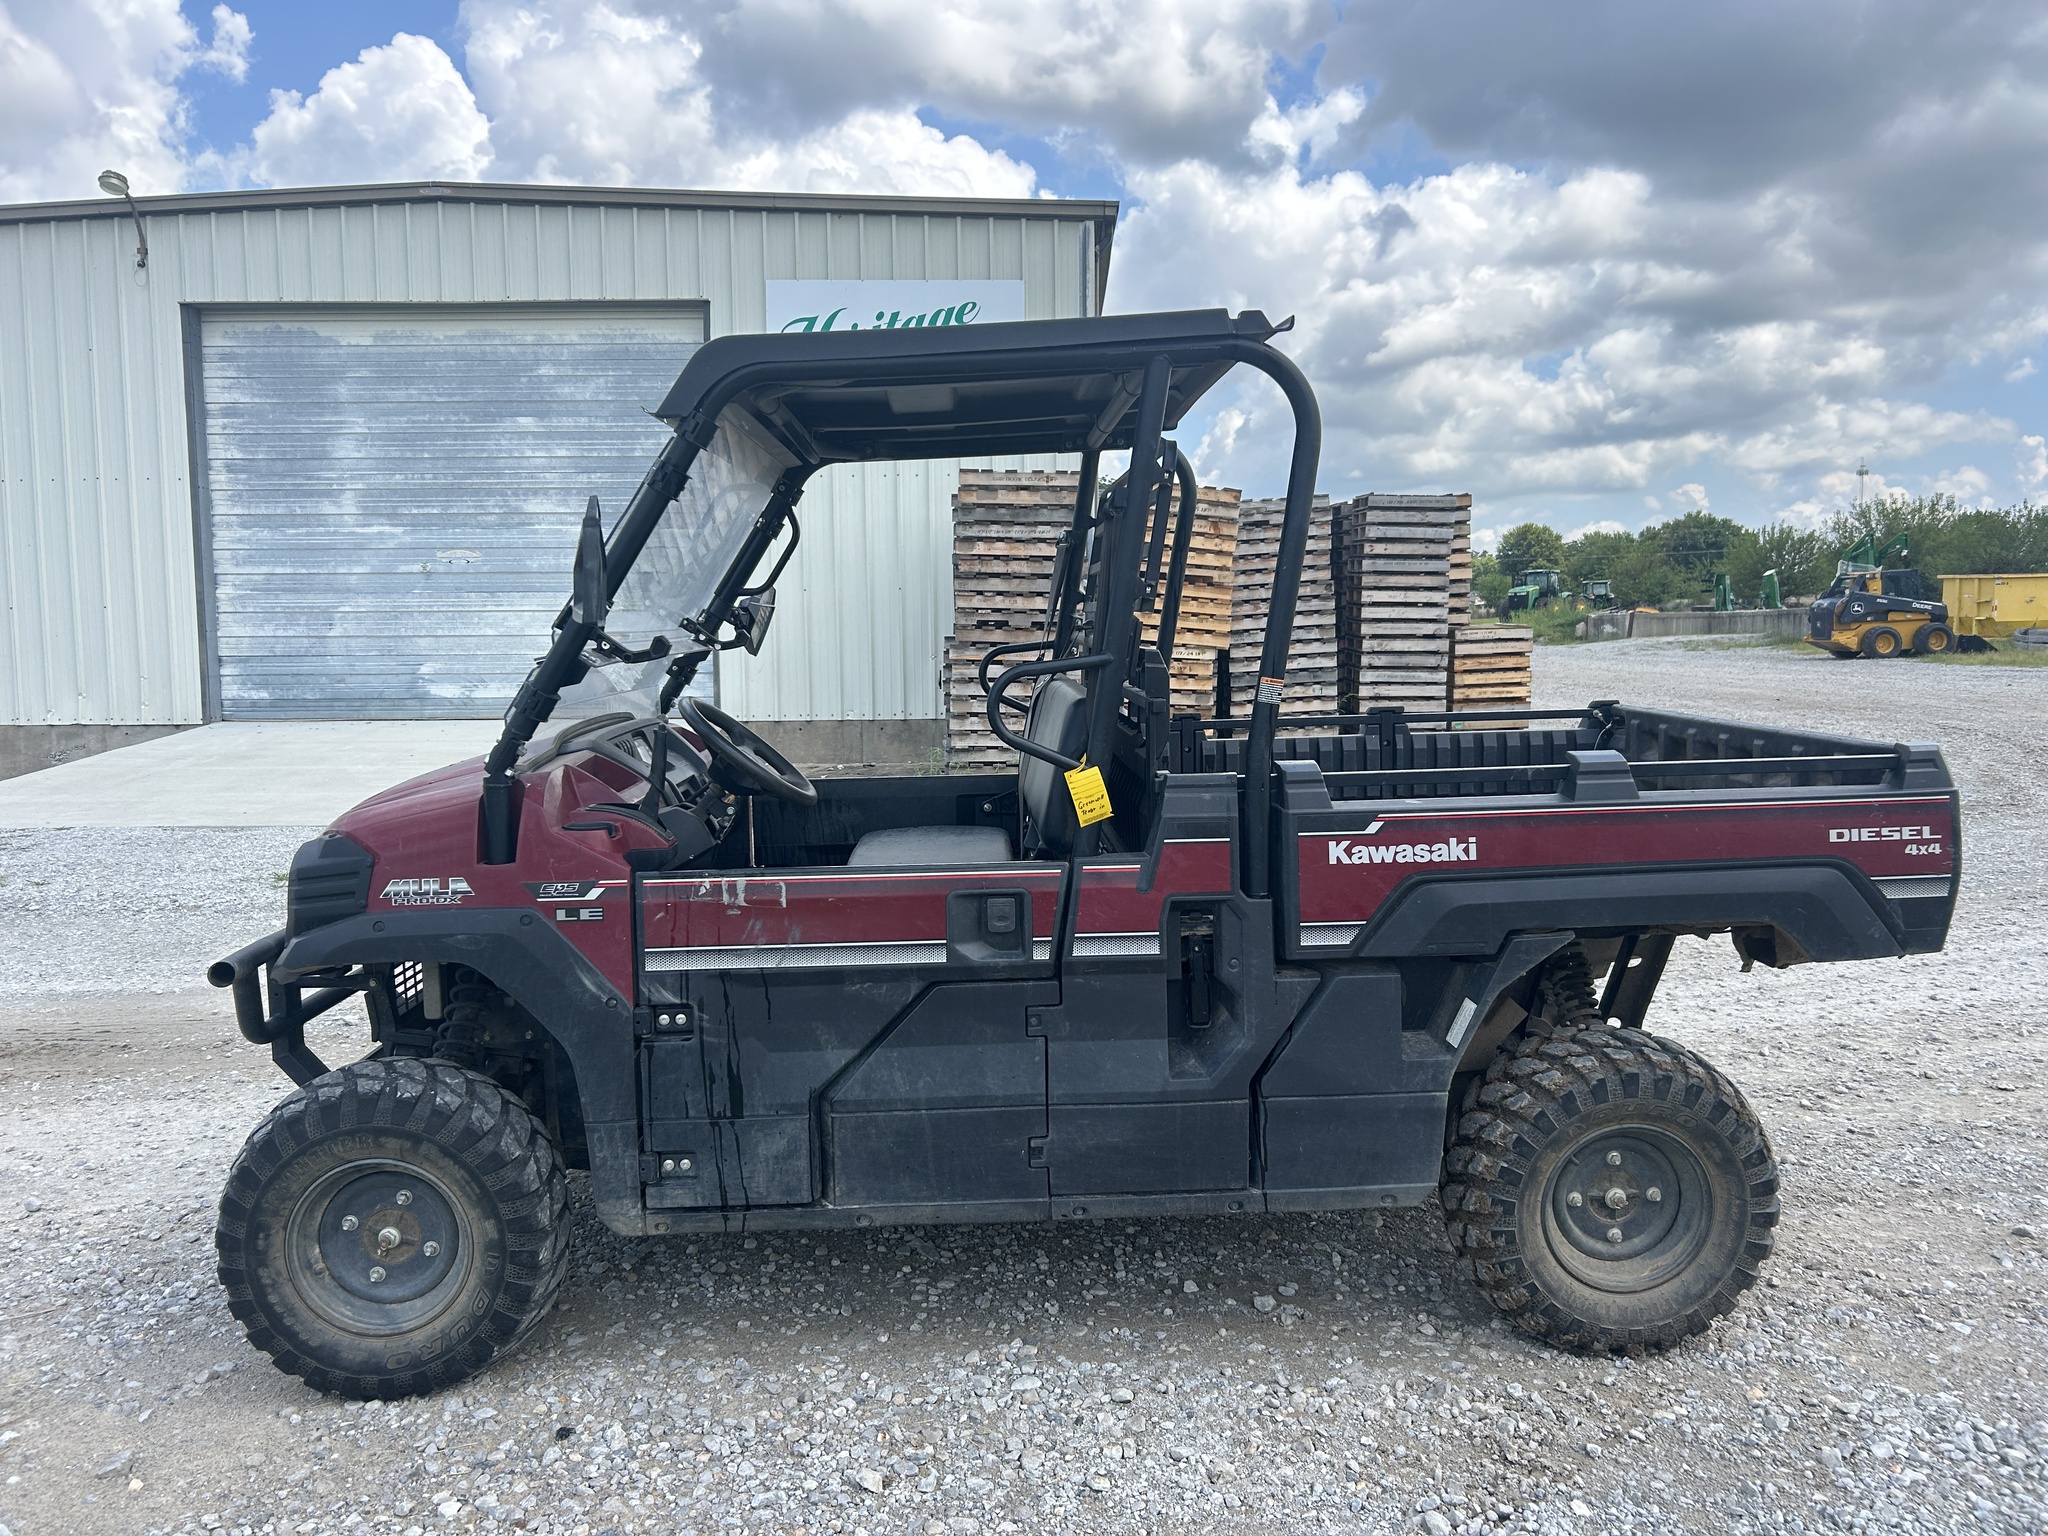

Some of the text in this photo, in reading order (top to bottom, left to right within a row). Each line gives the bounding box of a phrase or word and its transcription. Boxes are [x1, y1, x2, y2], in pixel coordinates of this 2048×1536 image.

[1829, 826, 1942, 843] DIESEL
[1328, 836, 1477, 865] Kawasaki
[1904, 843, 1942, 855] 4x4
[379, 876, 476, 898] MULE
[391, 896, 462, 906] PRO-DX
[556, 908, 603, 921] LE
[386, 1287, 492, 1370] DURO
